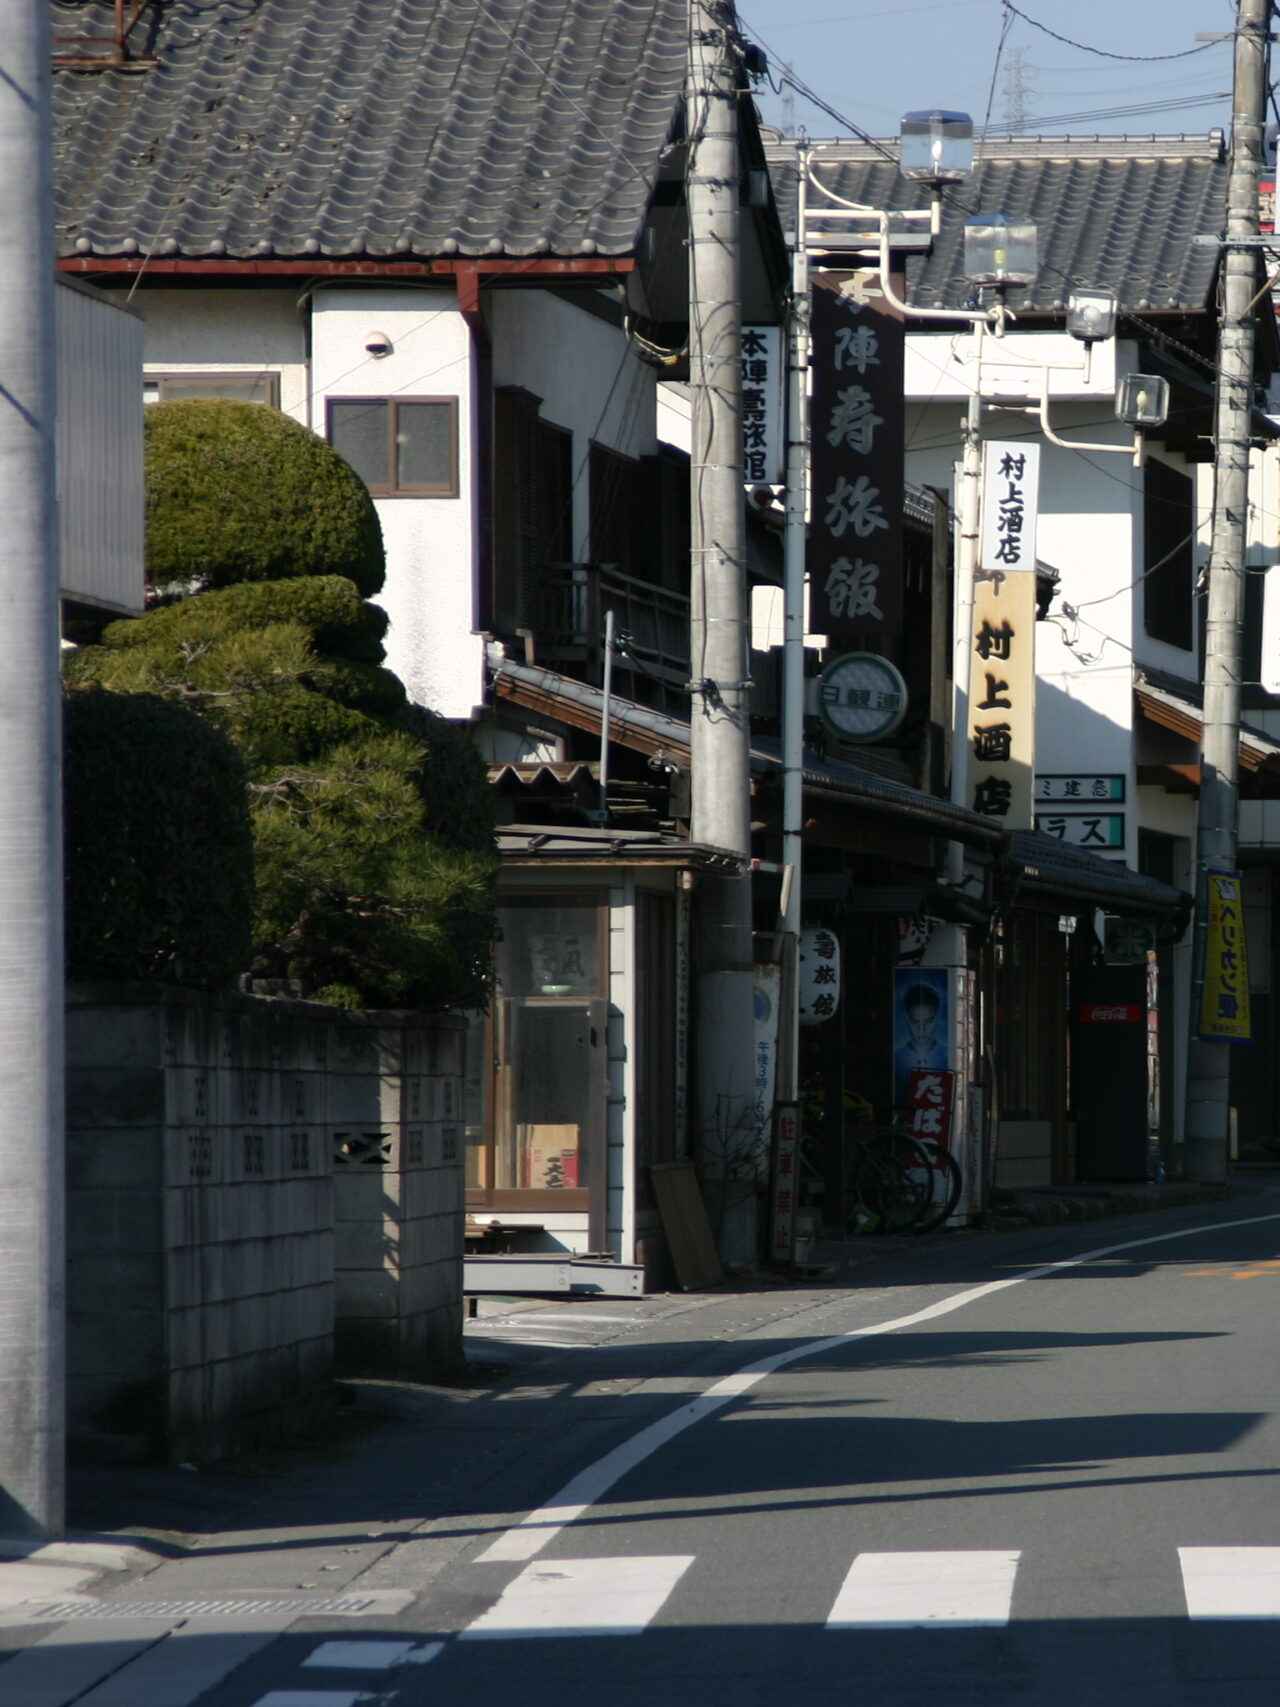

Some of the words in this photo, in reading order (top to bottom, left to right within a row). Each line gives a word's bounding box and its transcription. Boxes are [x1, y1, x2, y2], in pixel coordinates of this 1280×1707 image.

[995, 451, 1027, 564] 村上酒店
[973, 620, 1014, 817] 村上酒店
[1046, 818, 1106, 843] ラス
